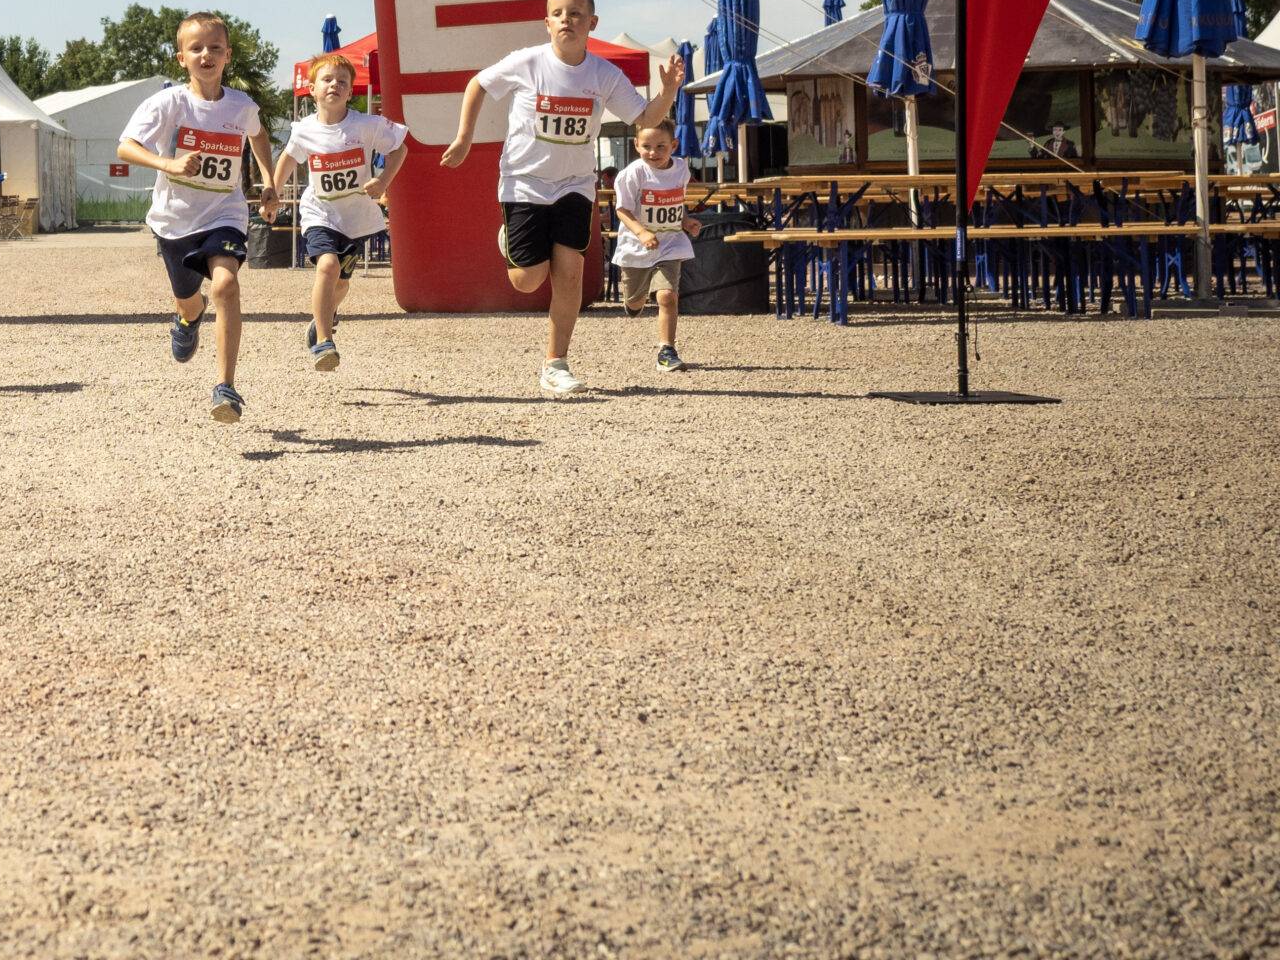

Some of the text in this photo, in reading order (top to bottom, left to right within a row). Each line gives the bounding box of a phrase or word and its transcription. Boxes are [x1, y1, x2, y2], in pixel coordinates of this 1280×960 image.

[553, 104, 590, 113] Sparkasse
[540, 115, 587, 136] 1183
[200, 140, 241, 152] Sparkasse
[324, 157, 362, 169] Sparkasse
[320, 169, 360, 193] 662
[645, 205, 683, 224] 1082
